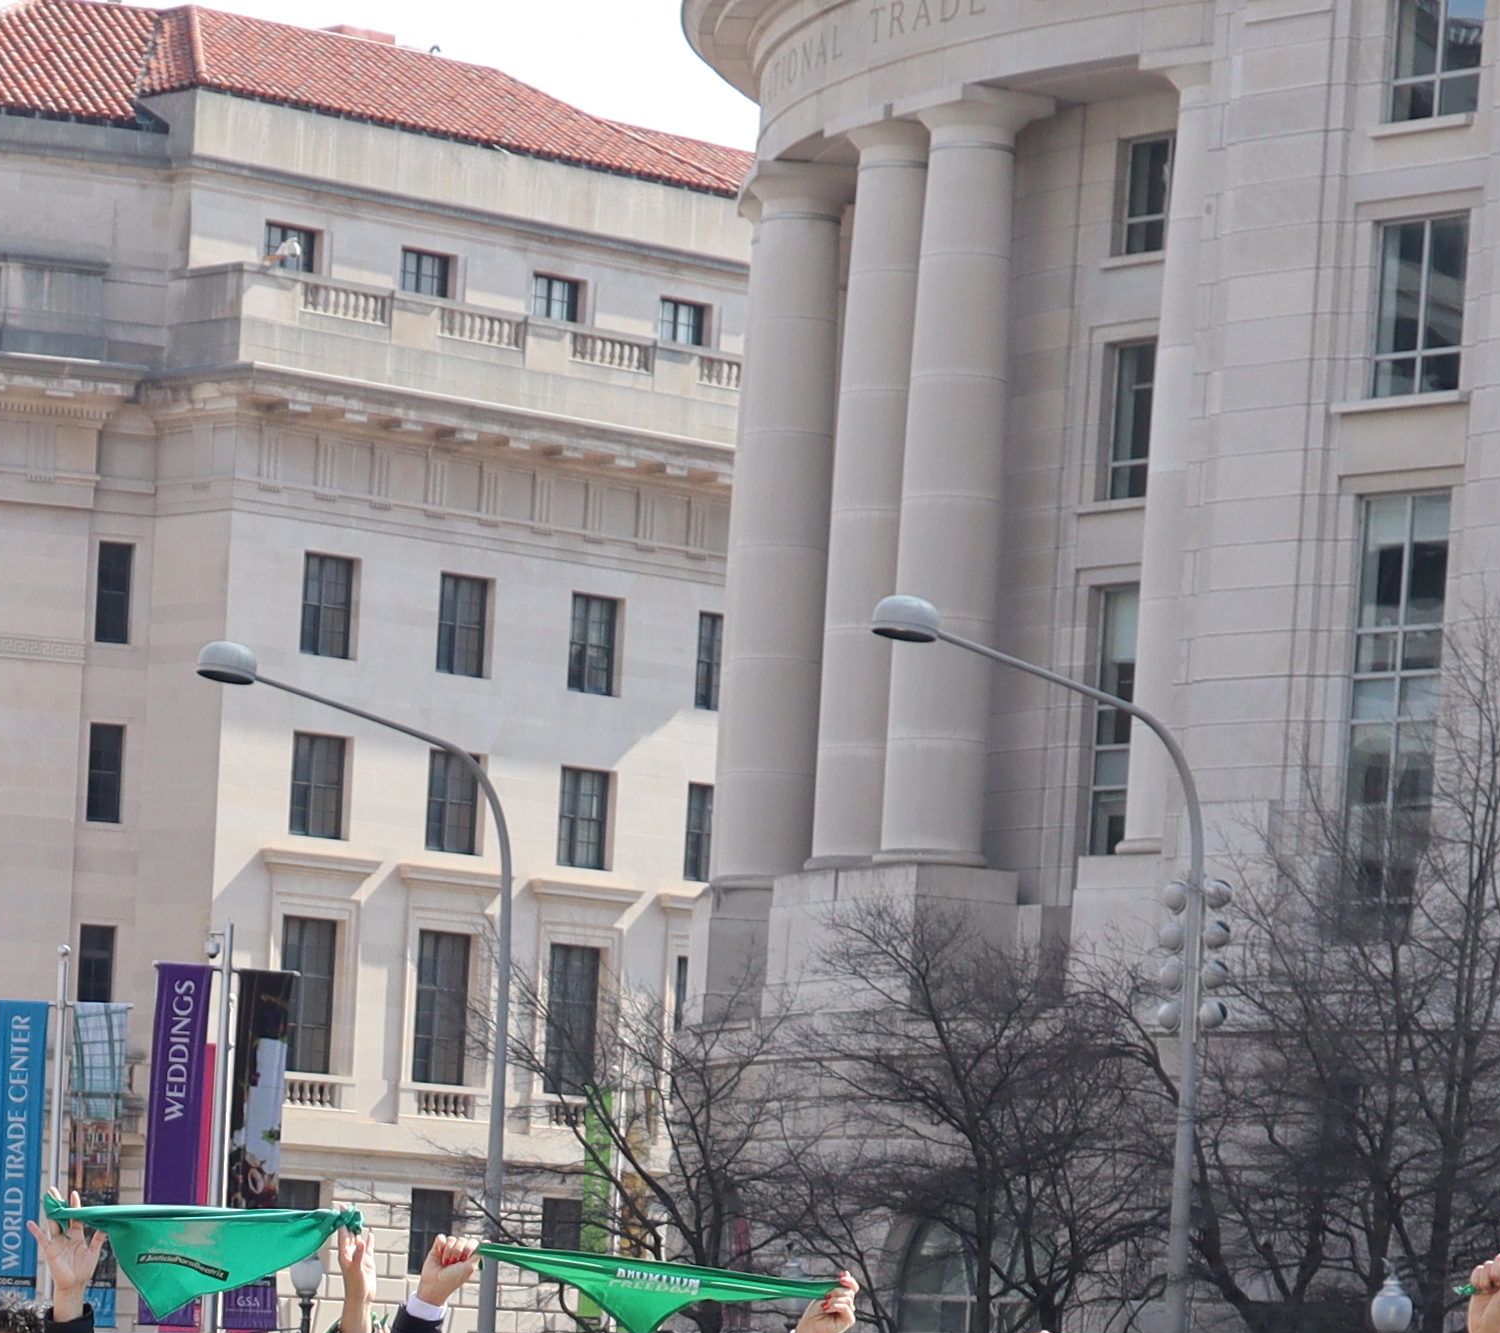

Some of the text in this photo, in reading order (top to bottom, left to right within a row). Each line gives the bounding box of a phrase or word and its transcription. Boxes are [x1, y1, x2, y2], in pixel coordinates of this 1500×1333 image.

[7, 1014, 32, 1104] CENTER
[163, 979, 195, 1122] WEDDINGS
[4, 1110, 28, 1181] TRADE
[0, 1187, 24, 1271] WORLD
[236, 1295, 260, 1307] GSA
